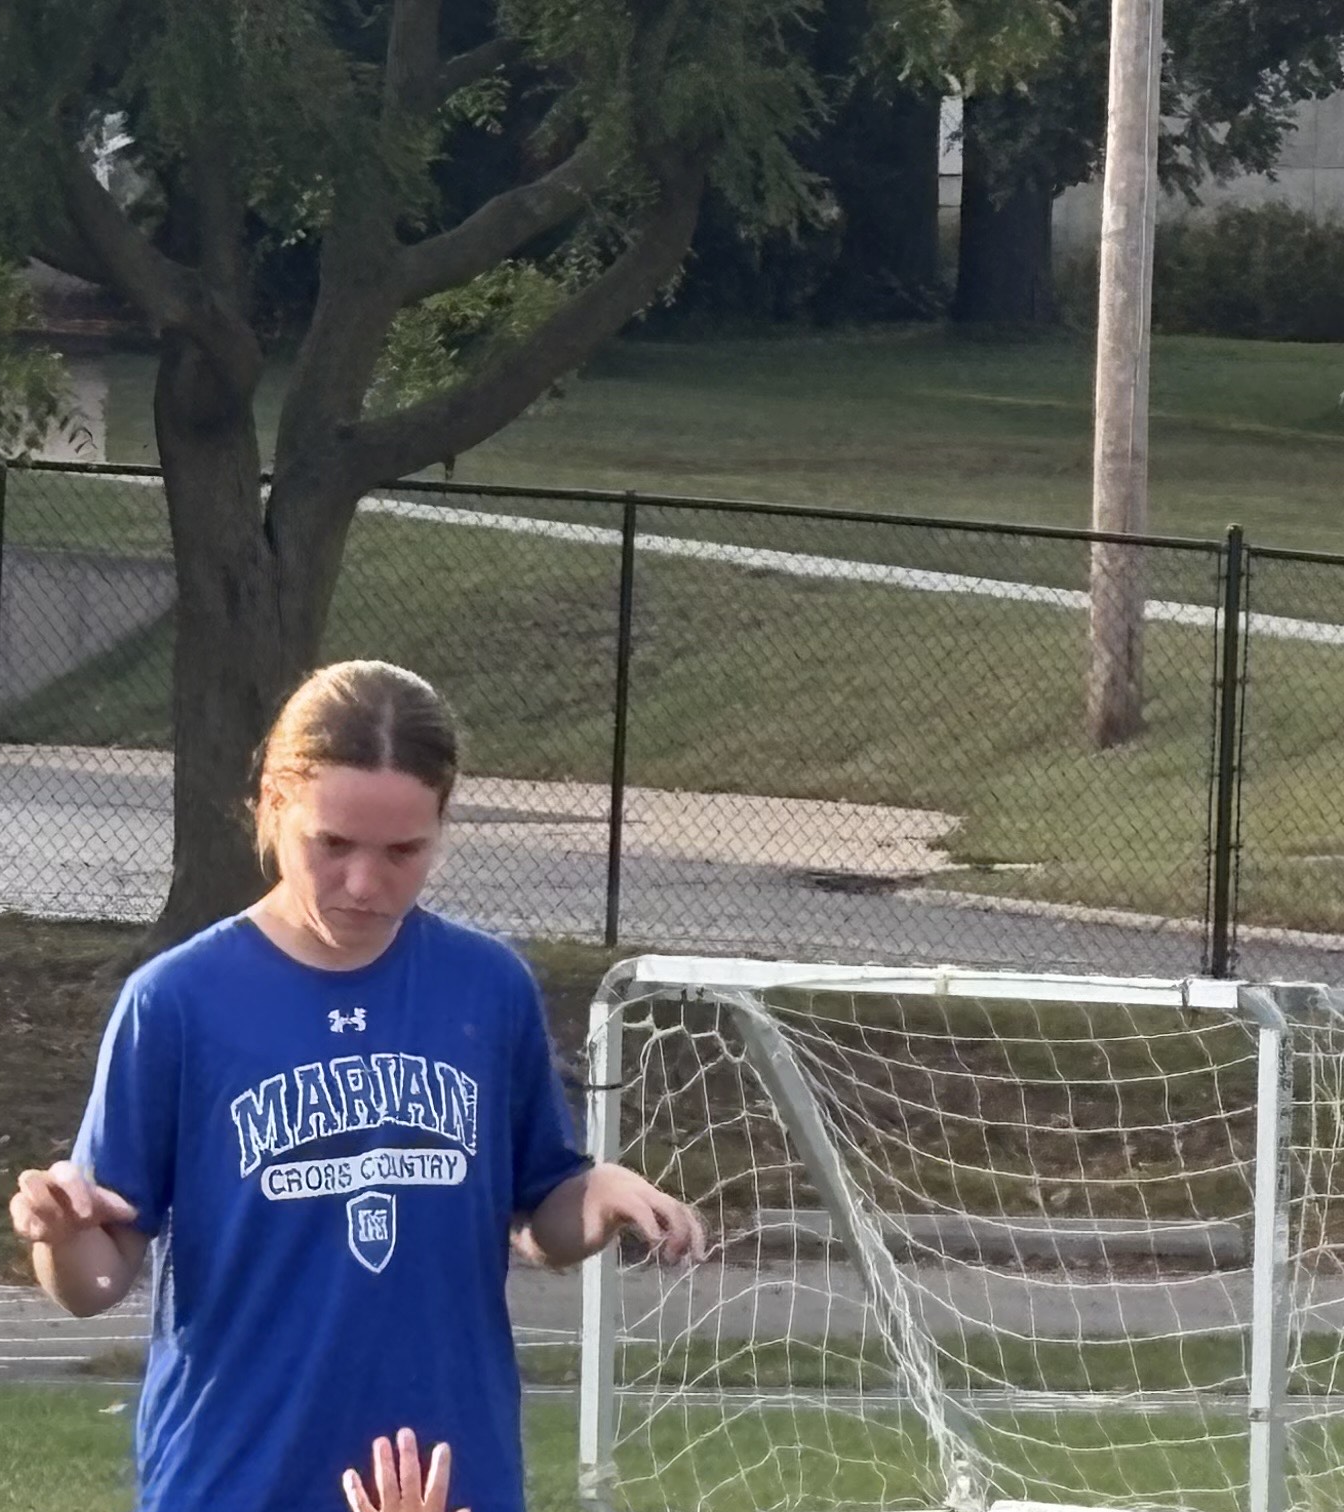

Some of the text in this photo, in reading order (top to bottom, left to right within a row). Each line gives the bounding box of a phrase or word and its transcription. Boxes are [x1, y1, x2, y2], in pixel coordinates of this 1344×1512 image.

[230, 1052, 478, 1178] MARIAN
[268, 1150, 459, 1195] CROSS COUNTRY
